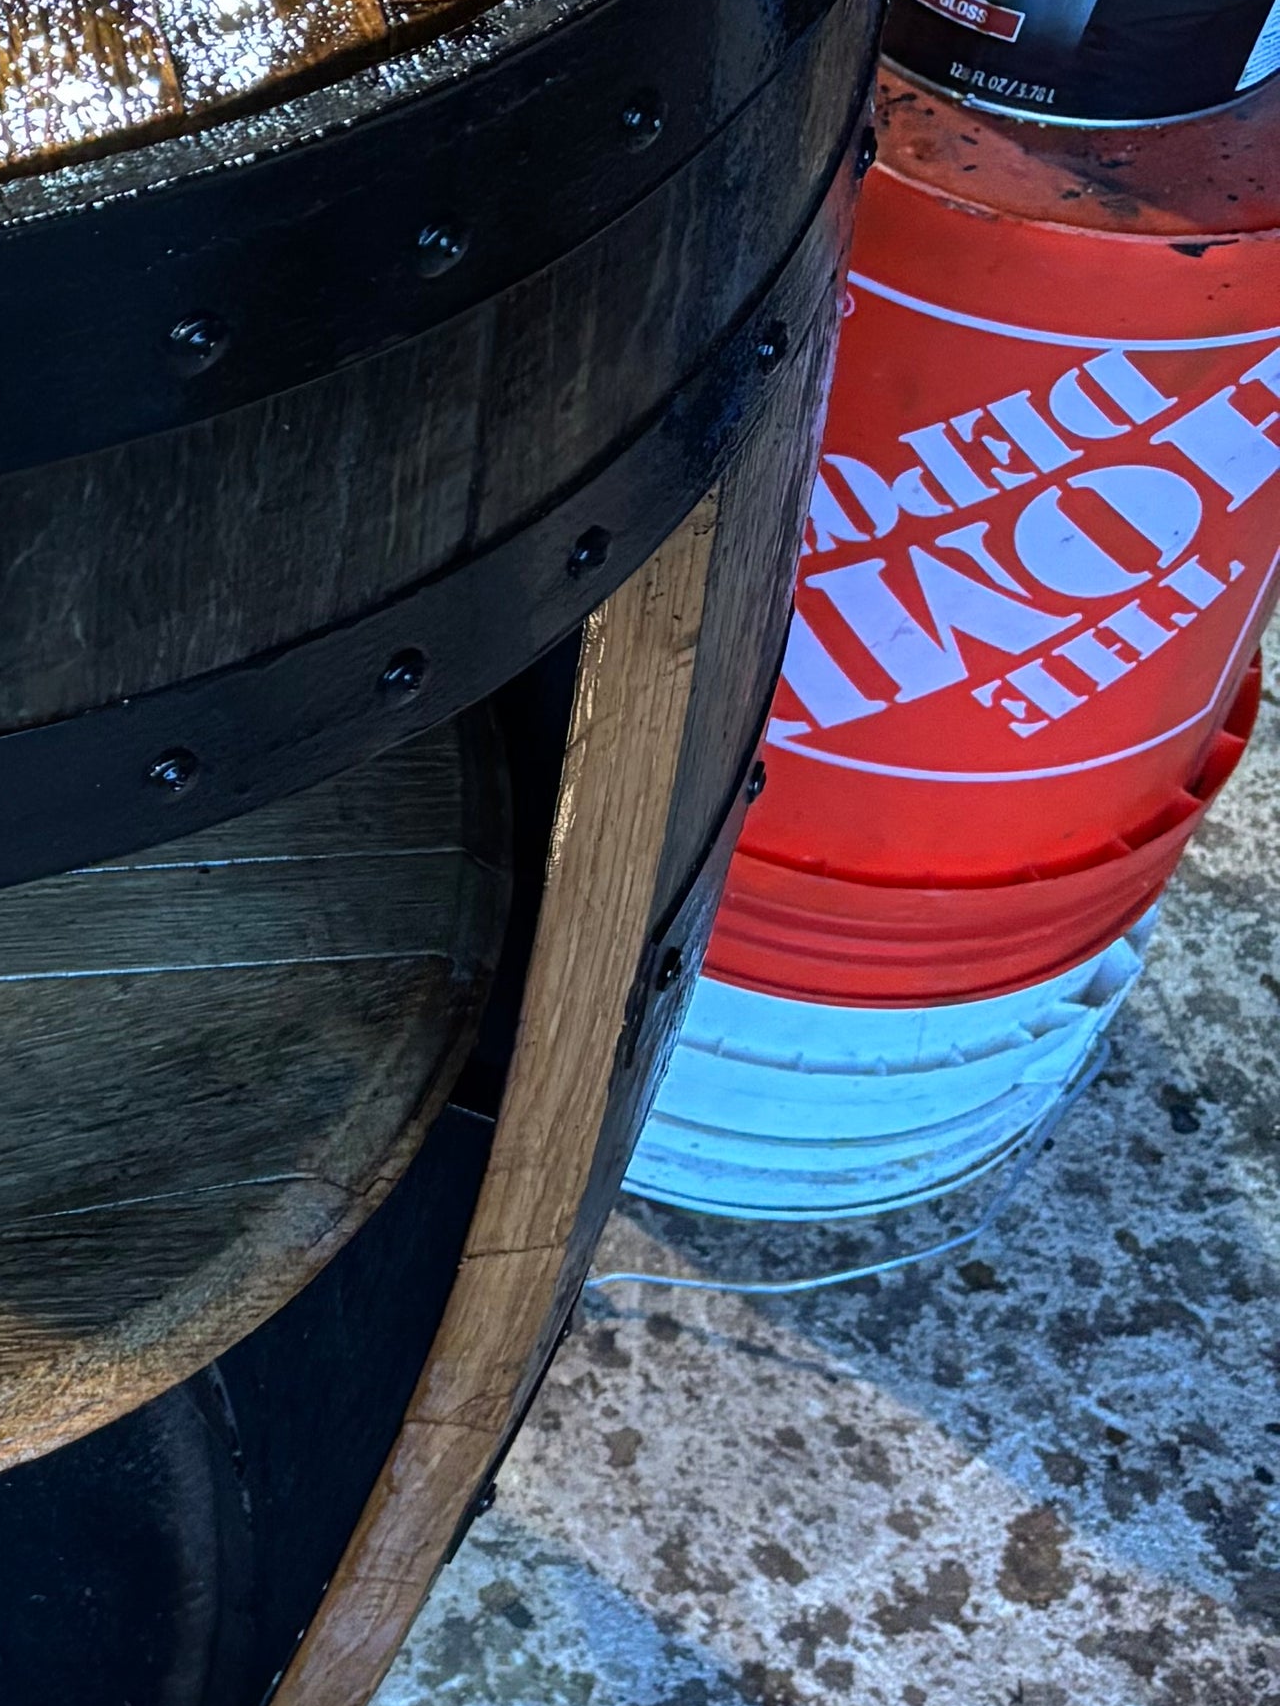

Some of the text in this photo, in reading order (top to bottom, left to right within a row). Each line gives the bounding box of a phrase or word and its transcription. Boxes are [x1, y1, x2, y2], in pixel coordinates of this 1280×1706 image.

[972, 70, 985, 87] FL
[988, 77, 1008, 94] OZ
[801, 348, 1178, 555] DEPO
[971, 554, 1245, 738] THE
